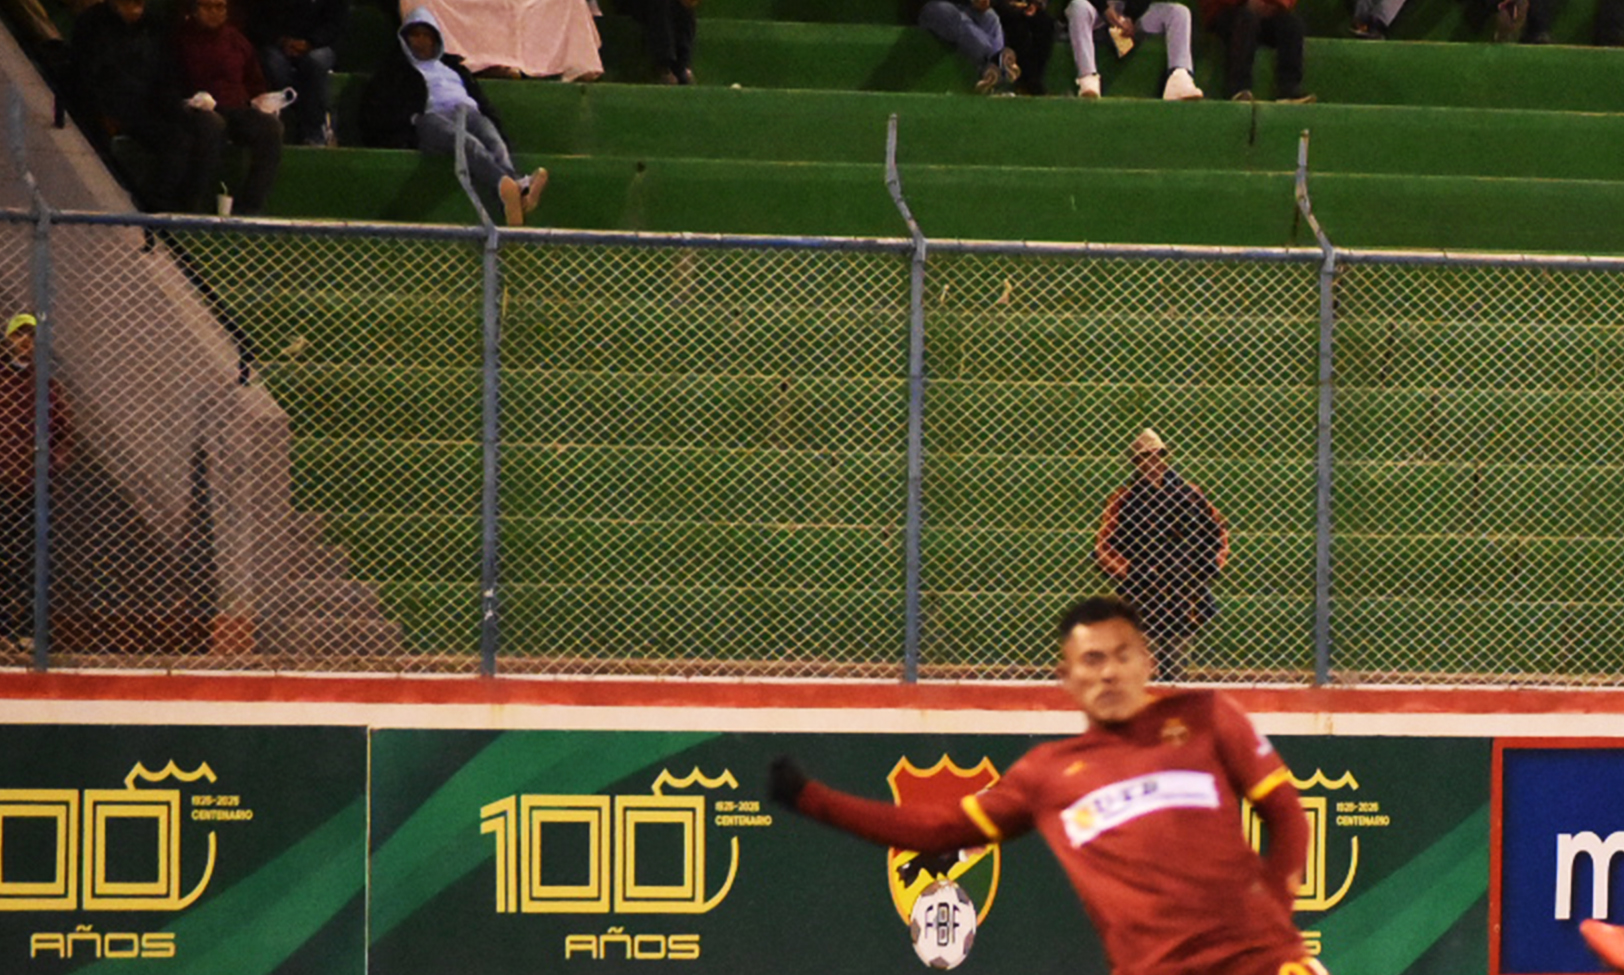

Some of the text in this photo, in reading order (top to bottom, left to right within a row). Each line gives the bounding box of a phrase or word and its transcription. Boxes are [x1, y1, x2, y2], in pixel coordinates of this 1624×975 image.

[191, 809, 254, 821] CENTENARIO
[714, 814, 773, 826] CENTENARIO
[1336, 814, 1391, 827] CENTENARIO
[480, 794, 706, 913] 100
[31, 924, 176, 959] AÑOS
[565, 926, 700, 960] AÑOS
